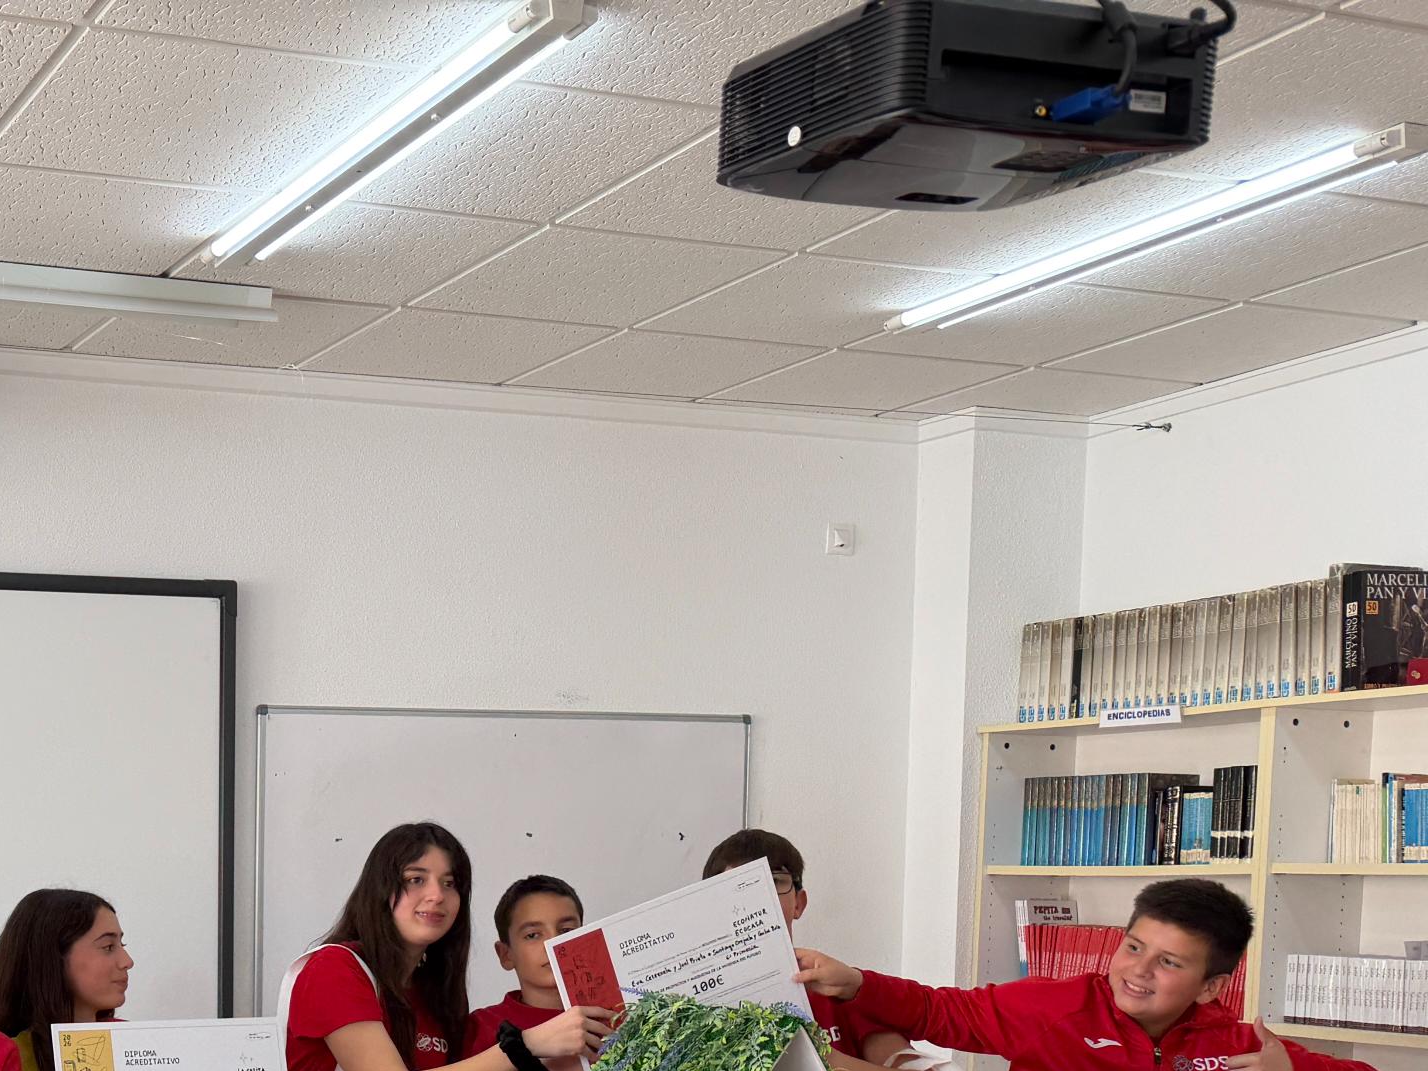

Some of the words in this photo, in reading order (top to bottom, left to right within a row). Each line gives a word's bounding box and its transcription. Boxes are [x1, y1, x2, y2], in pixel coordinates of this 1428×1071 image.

[1366, 587, 1394, 599] PAN
[1400, 587, 1408, 599] Y
[1367, 602, 1377, 611] 50
[1107, 708, 1171, 721] ENCICLOPEDIAS
[619, 933, 651, 949] DIPLOMA
[623, 932, 675, 957] ACREDITATIVO
[692, 974, 724, 995] 100€
[126, 1058, 180, 1066] ACREDITATIVO
